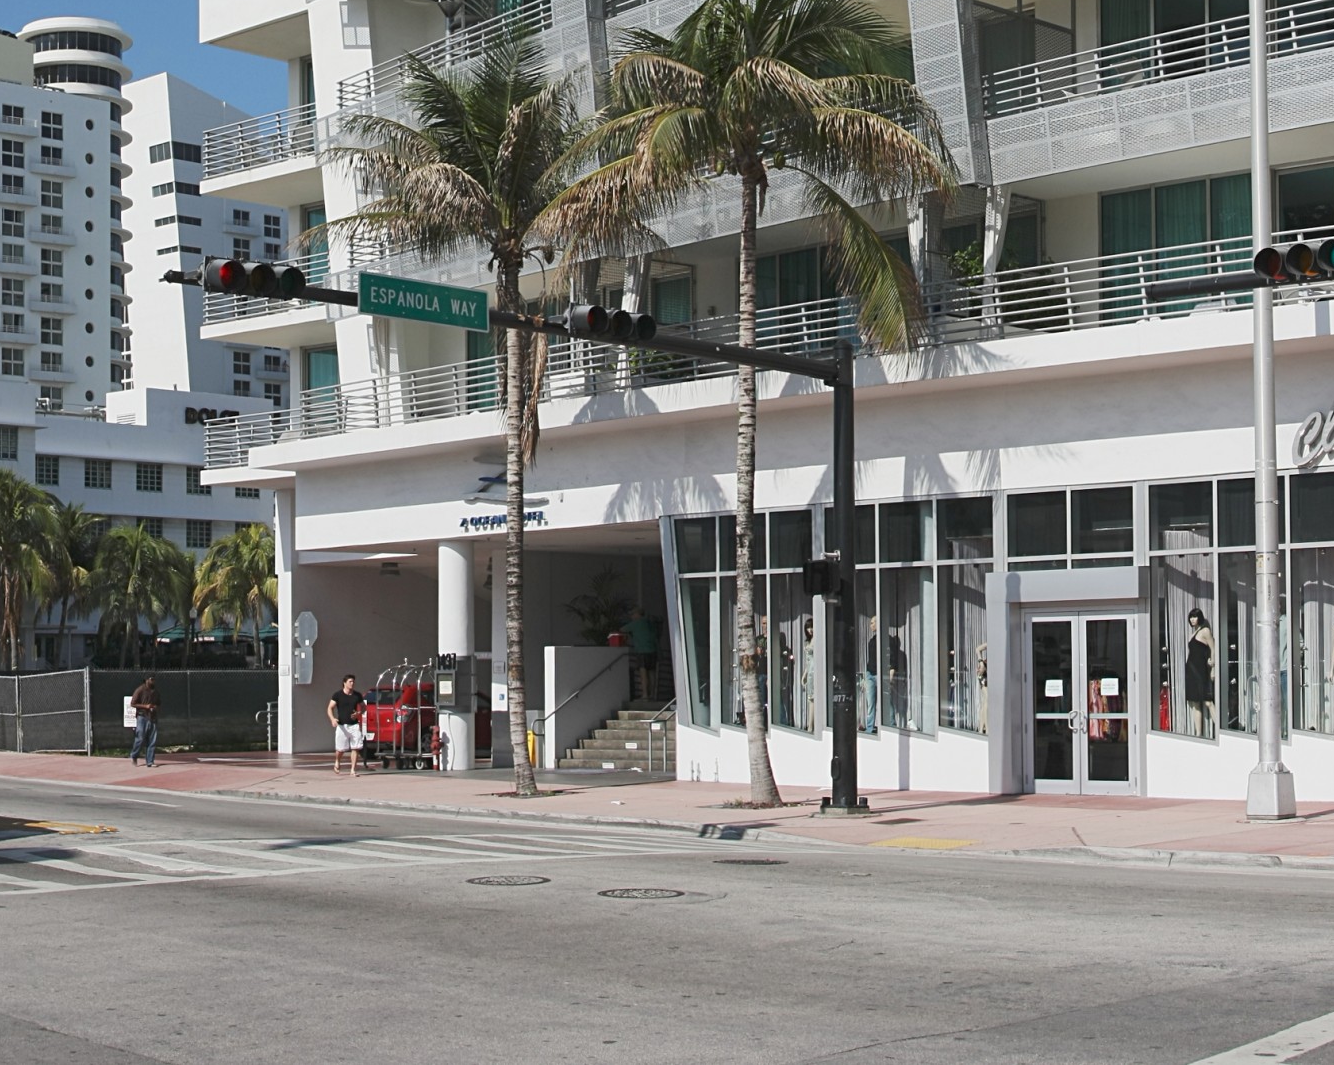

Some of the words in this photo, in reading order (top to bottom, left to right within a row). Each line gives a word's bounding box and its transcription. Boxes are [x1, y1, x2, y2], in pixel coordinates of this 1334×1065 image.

[370, 286, 440, 312] ESPANOLA
[451, 299, 477, 317] WAY
[523, 511, 545, 522] OTEL
